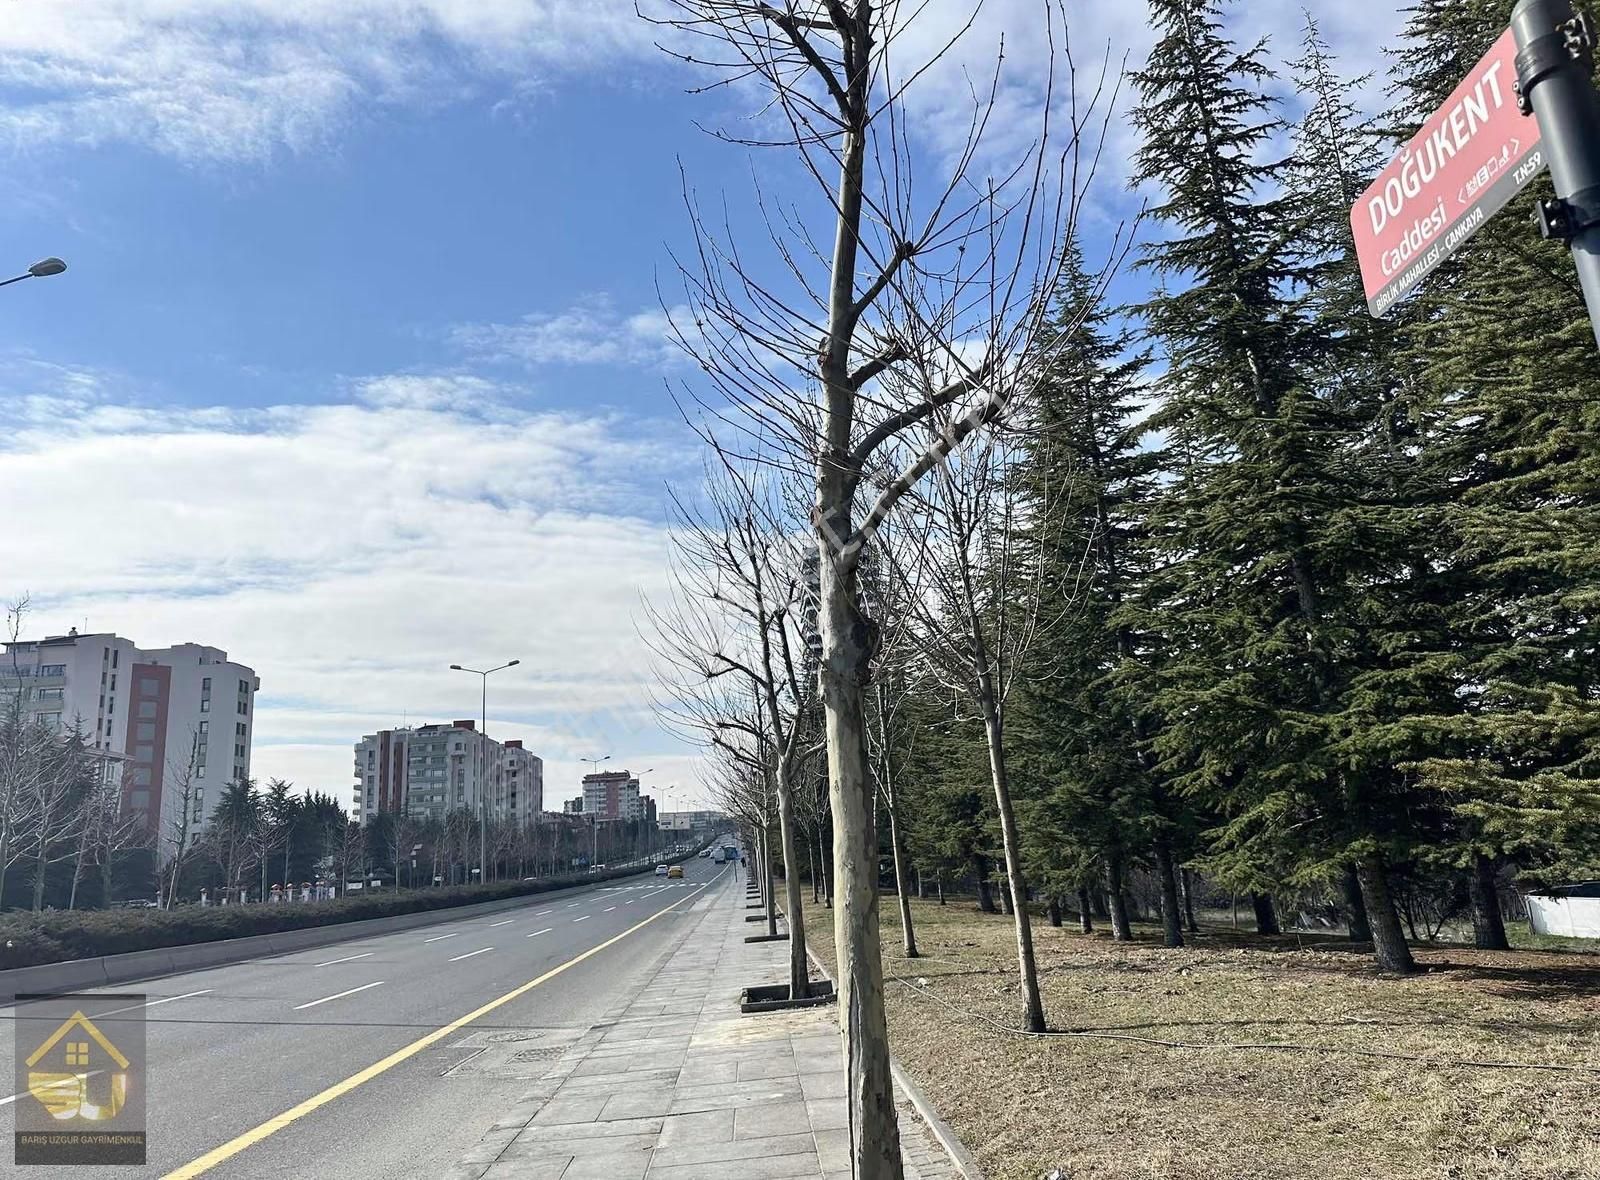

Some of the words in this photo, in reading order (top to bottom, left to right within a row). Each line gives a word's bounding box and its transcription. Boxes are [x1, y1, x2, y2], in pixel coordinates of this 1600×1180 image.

[1368, 59, 1504, 236] DOĞUKENT
[1376, 284, 1399, 311] BİRLİK
[1445, 206, 1484, 250] ÇANKAYA
[1381, 196, 1447, 276] Caddesi
